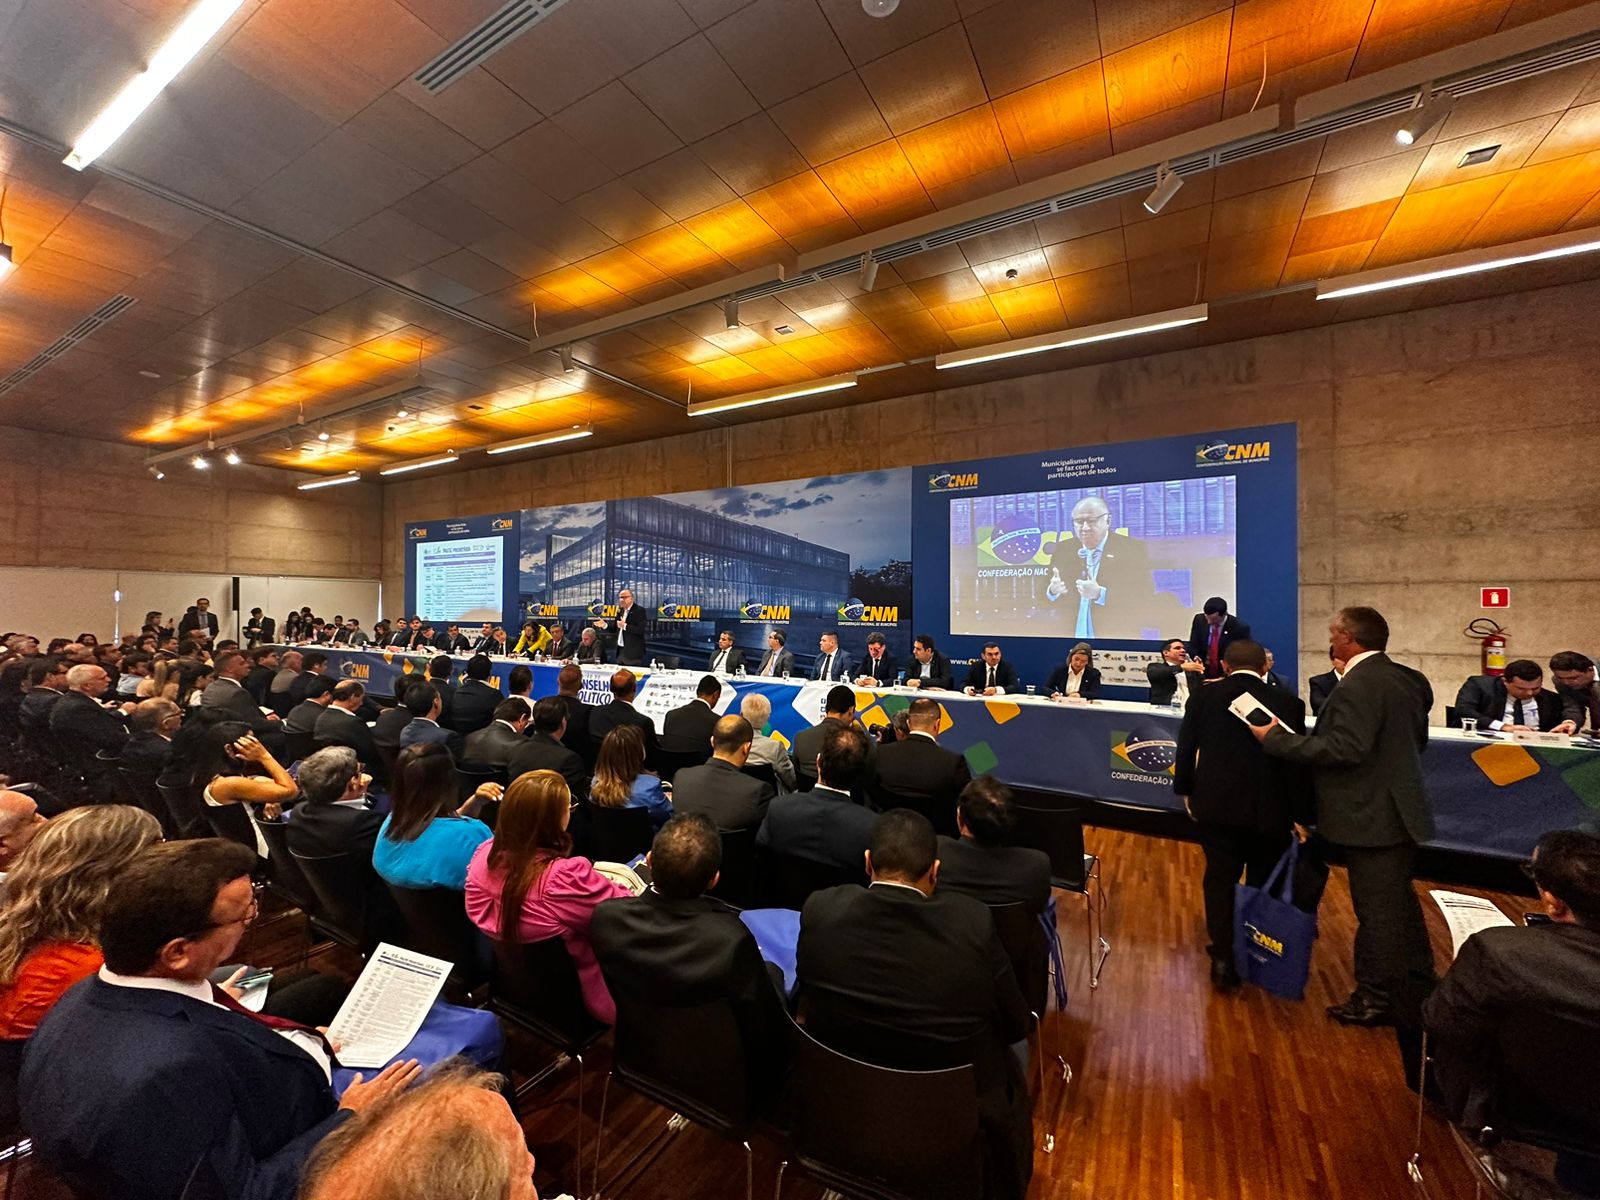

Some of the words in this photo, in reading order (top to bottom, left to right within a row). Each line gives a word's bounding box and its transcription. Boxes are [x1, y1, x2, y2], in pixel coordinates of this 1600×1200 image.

[1223, 441, 1270, 460] CNM
[1041, 458, 1087, 468] Municipalismo
[948, 473, 978, 487] CNM
[1047, 470, 1087, 480] participação
[1097, 466, 1117, 474] todos
[978, 567, 1032, 577] CONFEDERAÇÃO
[539, 604, 558, 616] CNM
[674, 605, 700, 618] CNM
[759, 605, 790, 620] CNM
[860, 606, 898, 621] CNM
[351, 664, 369, 678] CNM
[582, 679, 609, 692] NSELH
[578, 690, 611, 706] OLITICO
[1111, 771, 1168, 785] CONFEDERAÇÃO
[1253, 931, 1283, 953] CNM
